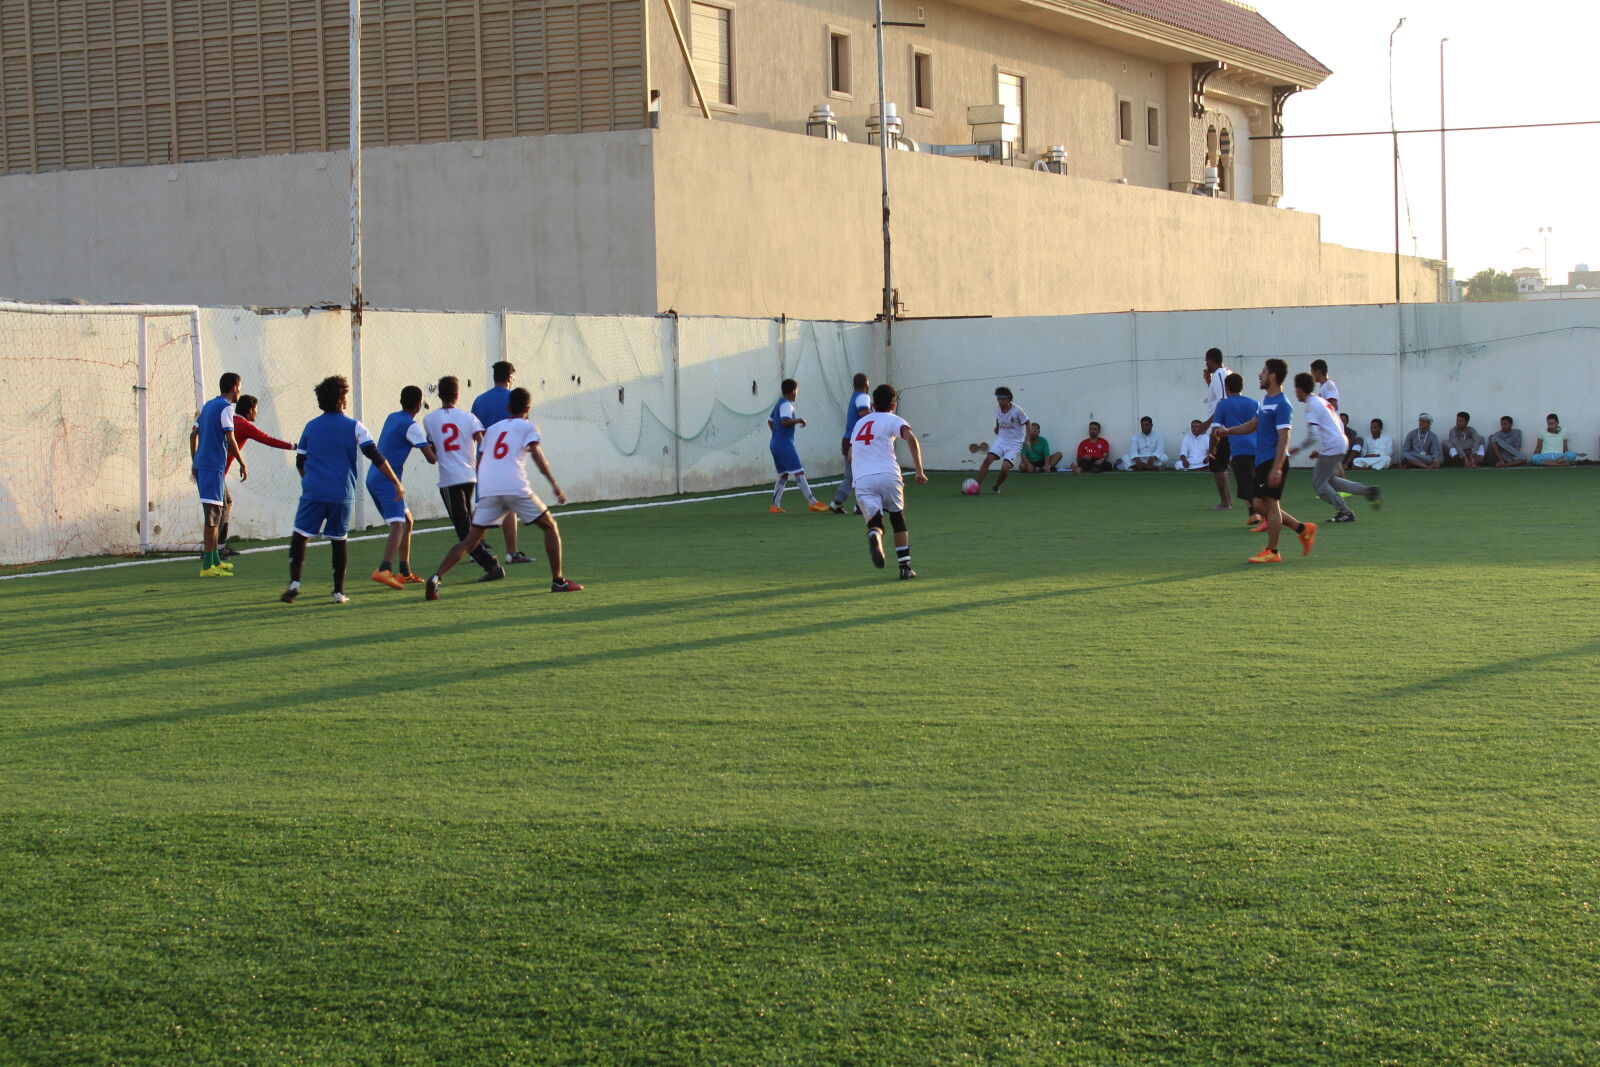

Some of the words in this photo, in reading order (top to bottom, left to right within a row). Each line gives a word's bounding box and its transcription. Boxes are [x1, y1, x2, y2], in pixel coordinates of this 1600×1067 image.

[441, 423, 460, 451] 2
[494, 431, 508, 459] 6
[855, 420, 875, 446] 4
